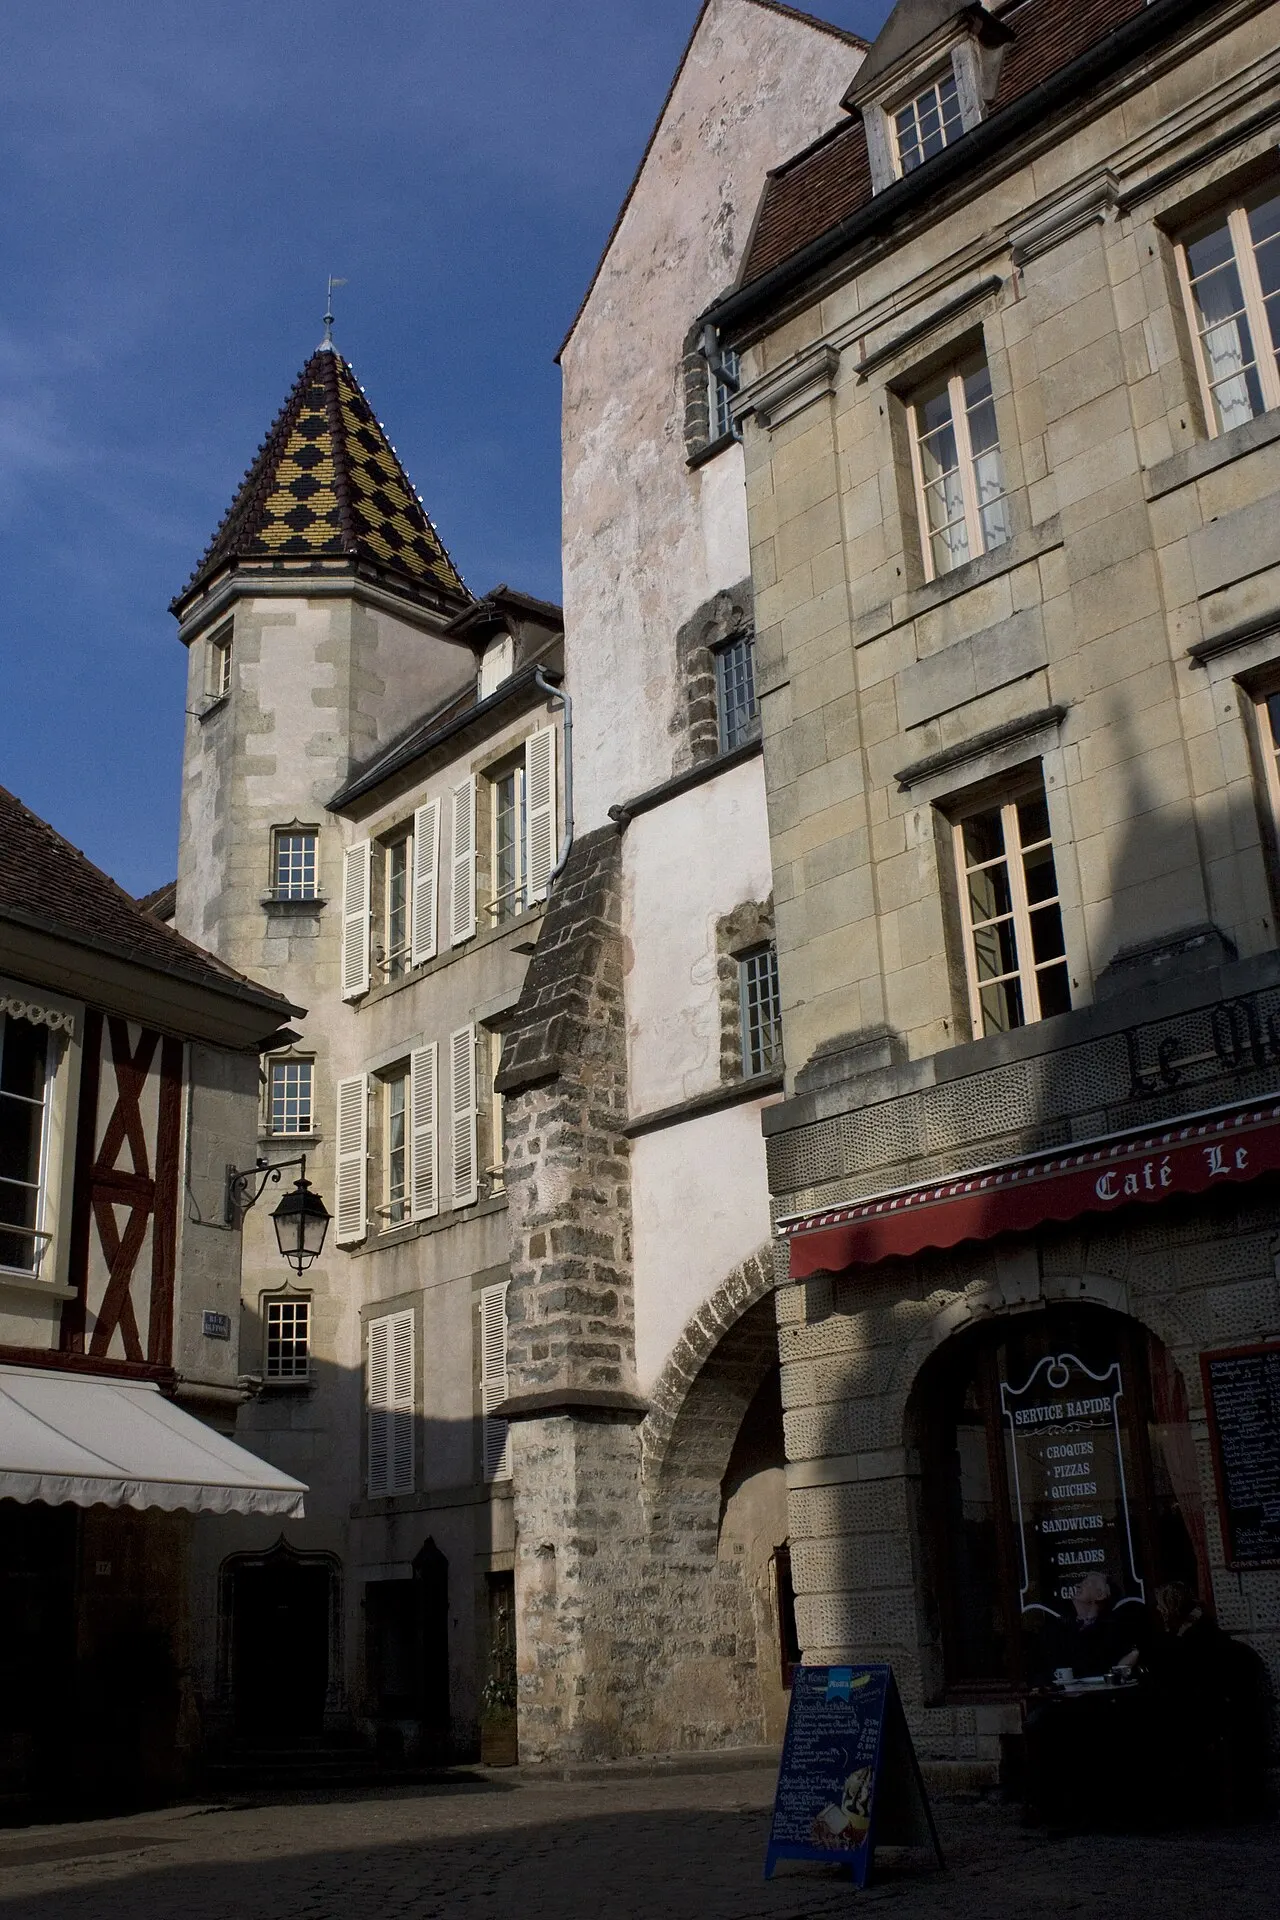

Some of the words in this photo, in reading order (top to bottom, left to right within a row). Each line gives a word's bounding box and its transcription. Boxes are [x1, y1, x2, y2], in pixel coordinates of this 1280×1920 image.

[1124, 1026, 1181, 1097] Le
[1095, 1155, 1173, 1200] Café
[1203, 1143, 1249, 1177] Le
[1015, 1404, 1063, 1424] SERVICE
[1067, 1397, 1111, 1417] RAPIDE
[1046, 1441, 1094, 1459] CROQUES
[1053, 1462, 1090, 1478] PIZZAS
[1051, 1482, 1097, 1499] QUICHES
[1042, 1515, 1103, 1533] SANDWICHS
[1057, 1549, 1105, 1565] SALADES
